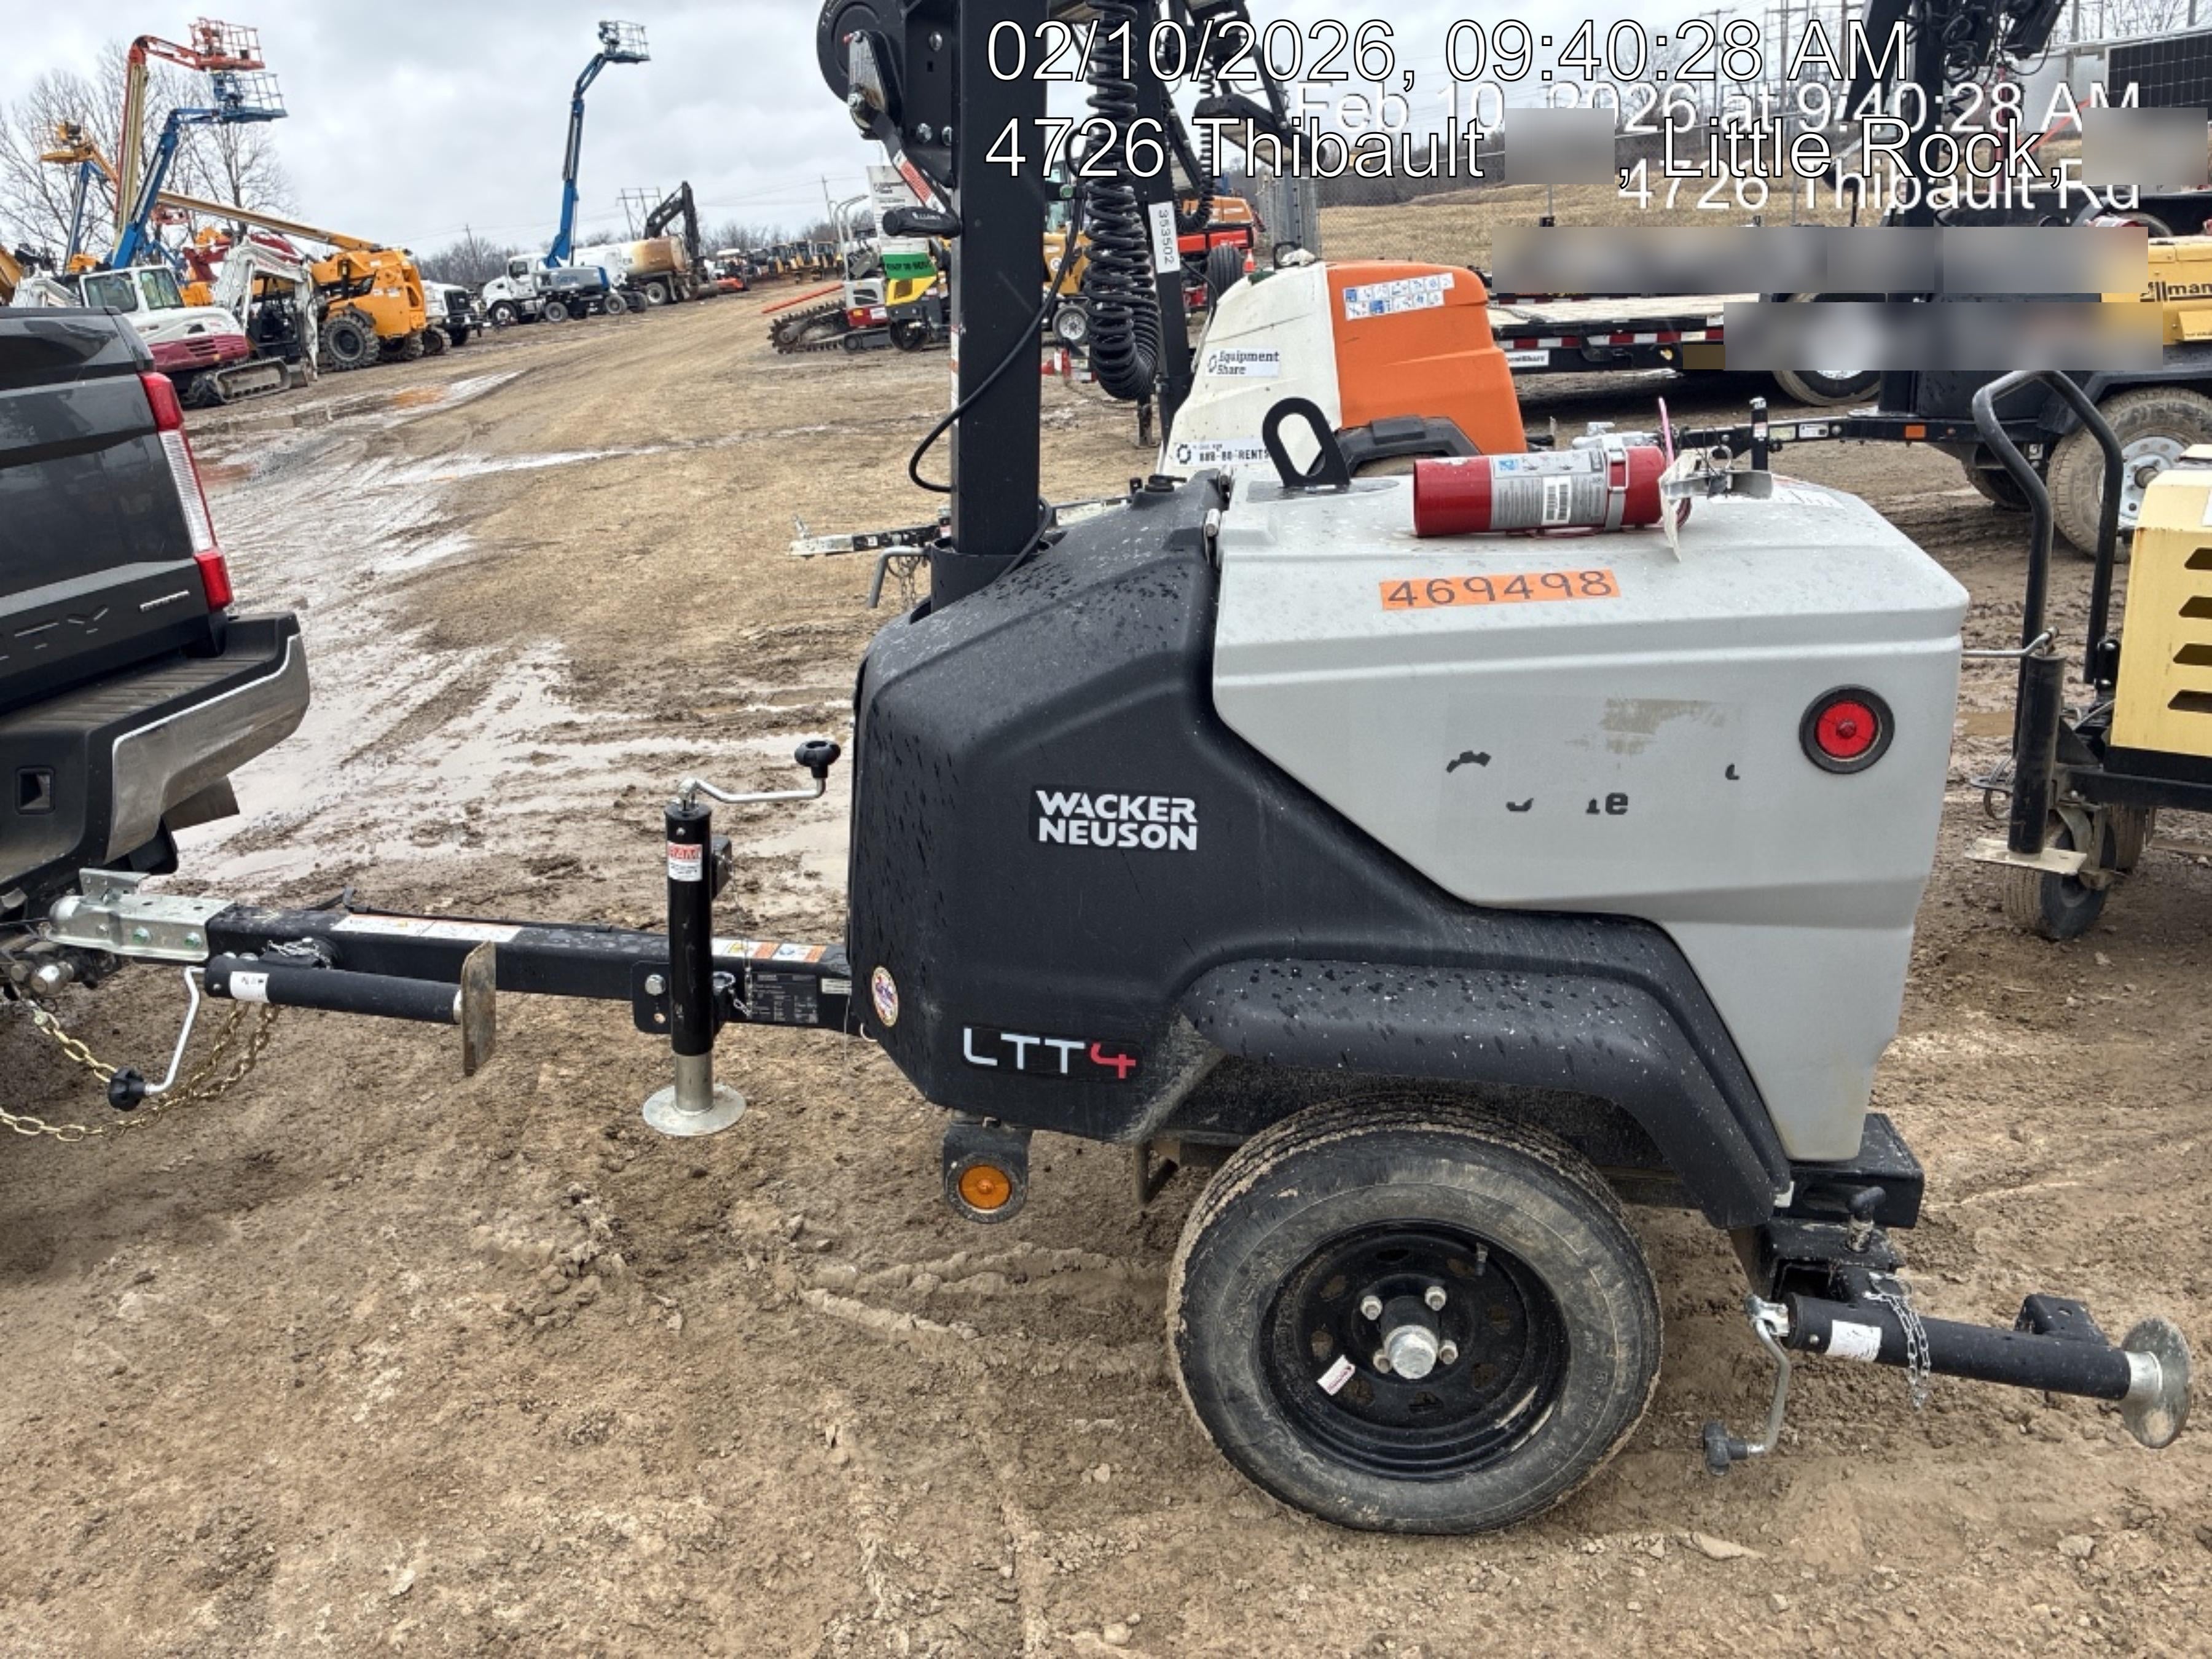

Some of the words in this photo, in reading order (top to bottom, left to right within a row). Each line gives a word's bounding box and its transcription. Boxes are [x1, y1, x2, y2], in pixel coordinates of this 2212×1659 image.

[1158, 209, 1175, 266] 353502
[1216, 365, 1247, 375] Share
[1218, 350, 1280, 363] Equipment
[1387, 570, 1613, 607] 469498
[1035, 790, 1198, 823] WACKER
[1038, 818, 1198, 851] NEUSON
[963, 1027, 1137, 1079] LTT4
